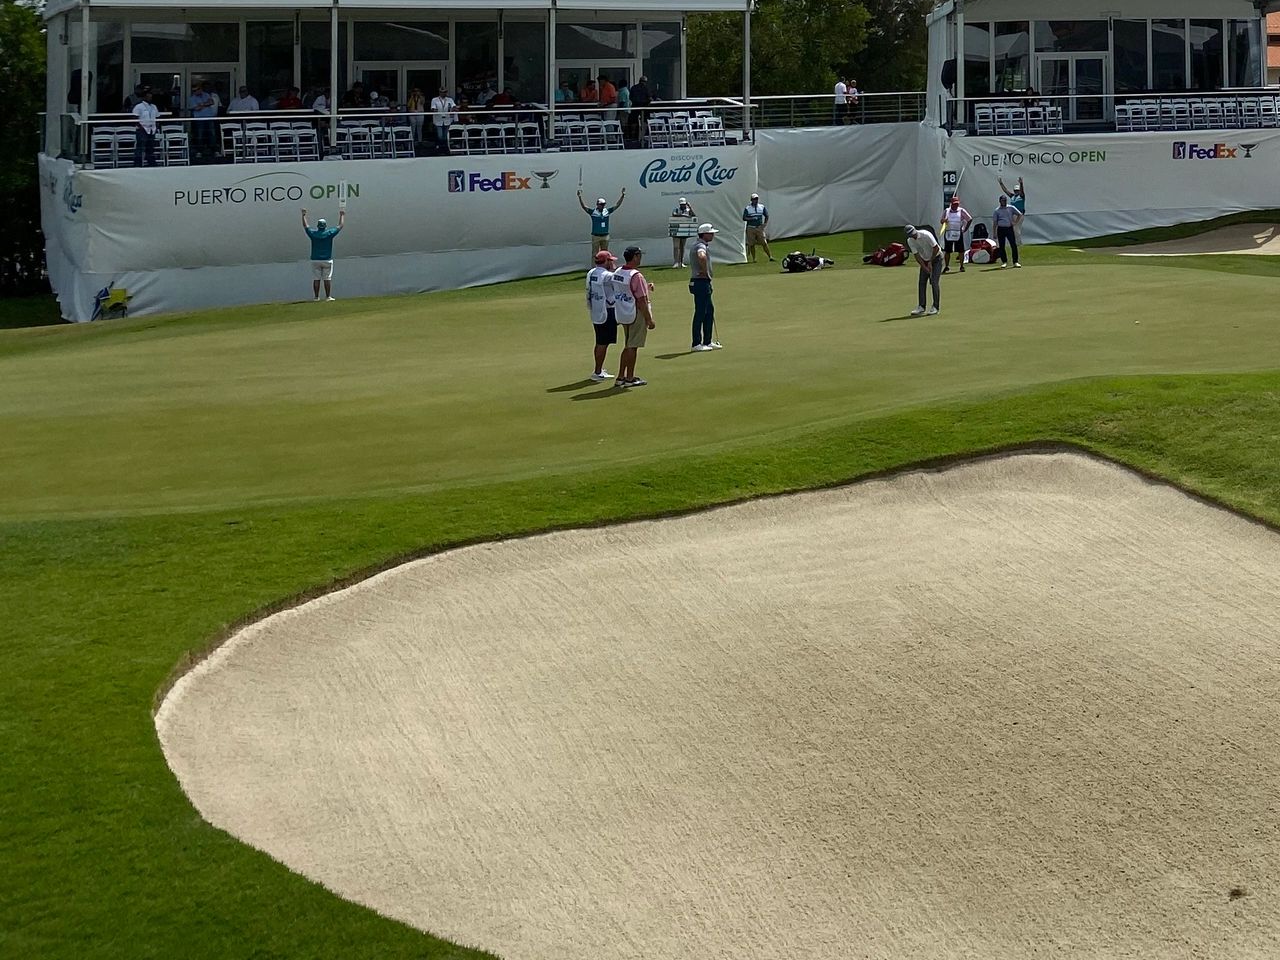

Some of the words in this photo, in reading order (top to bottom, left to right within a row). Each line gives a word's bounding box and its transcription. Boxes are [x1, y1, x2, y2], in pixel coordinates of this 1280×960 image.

[1028, 151, 1065, 165] RICO
[1069, 150, 1107, 163] OPEN
[1189, 143, 1237, 159] FedEx
[469, 171, 532, 192] FedEx
[639, 158, 696, 189] Puerto
[696, 158, 739, 186] Rico
[943, 173, 956, 183] 18
[174, 187, 247, 206] PUERTO
[254, 185, 303, 202] RICO
[310, 183, 360, 200] OPN
